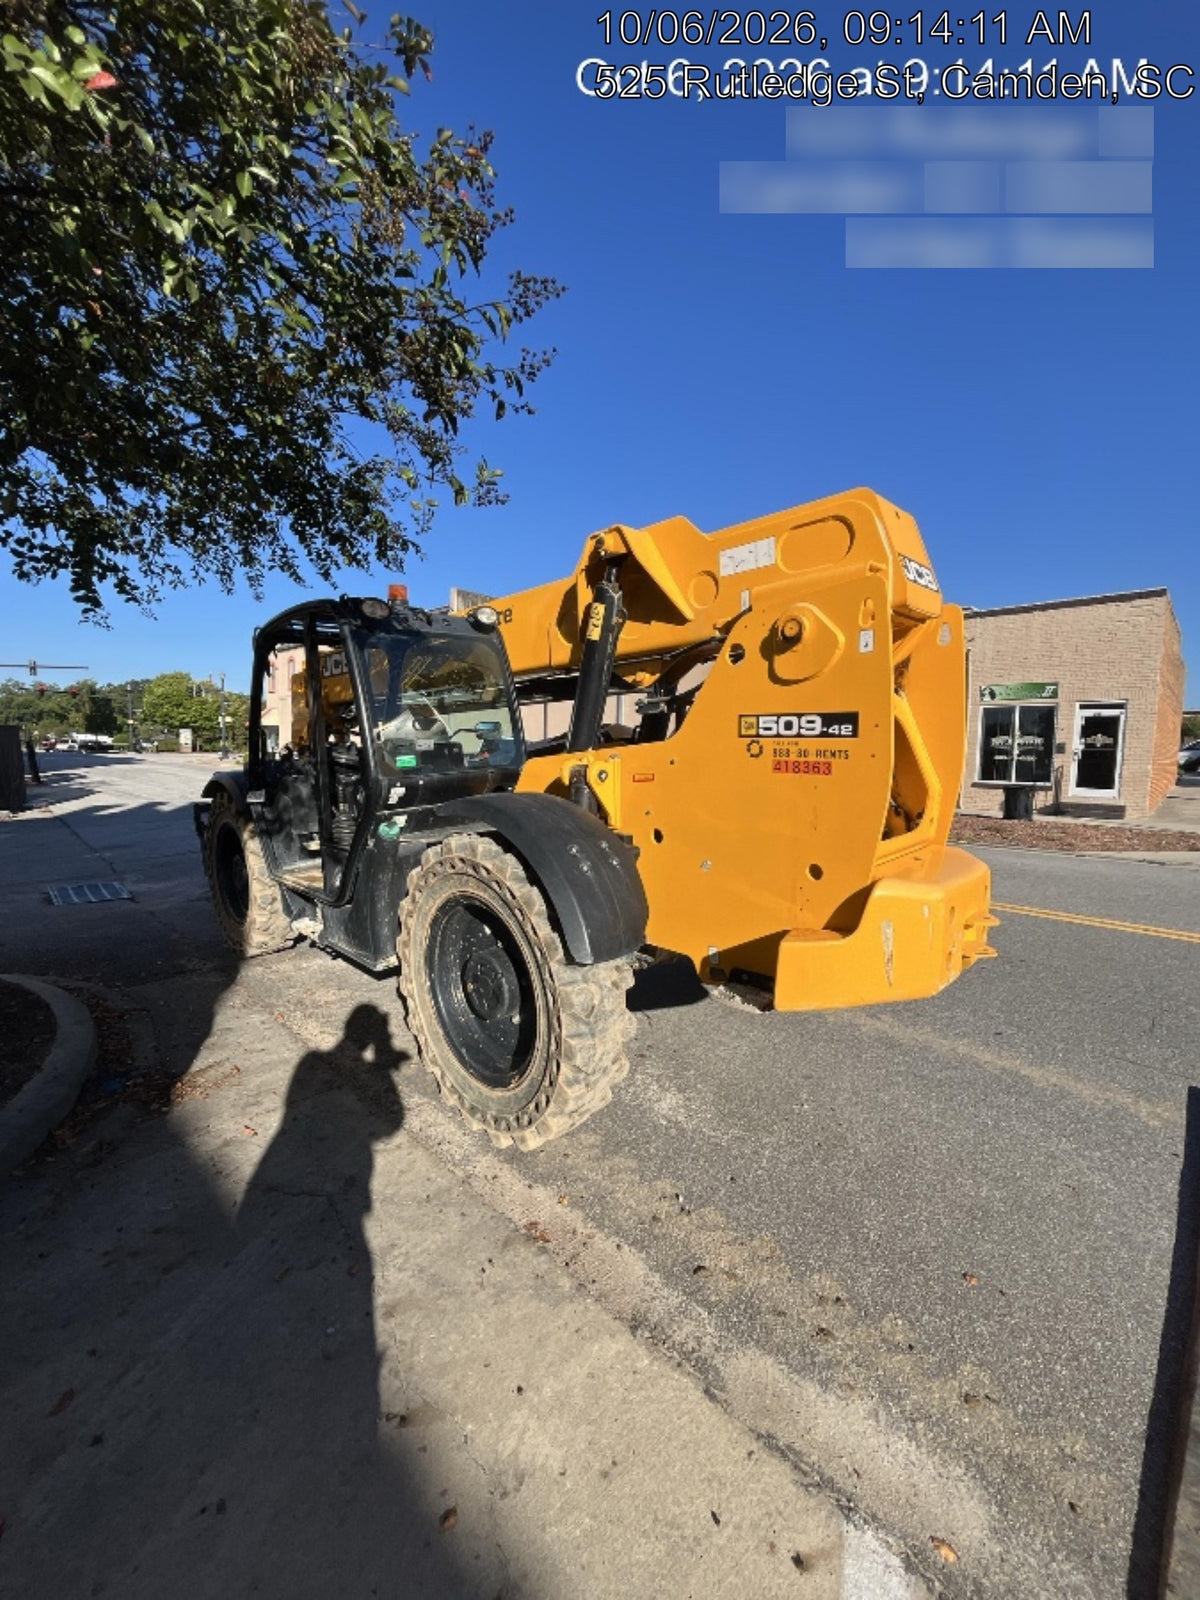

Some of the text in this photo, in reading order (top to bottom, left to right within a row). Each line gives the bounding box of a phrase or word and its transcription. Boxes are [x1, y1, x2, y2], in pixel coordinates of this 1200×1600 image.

[904, 558, 939, 590] JCB
[758, 714, 853, 736] 509-42
[773, 761, 833, 776] 418363
